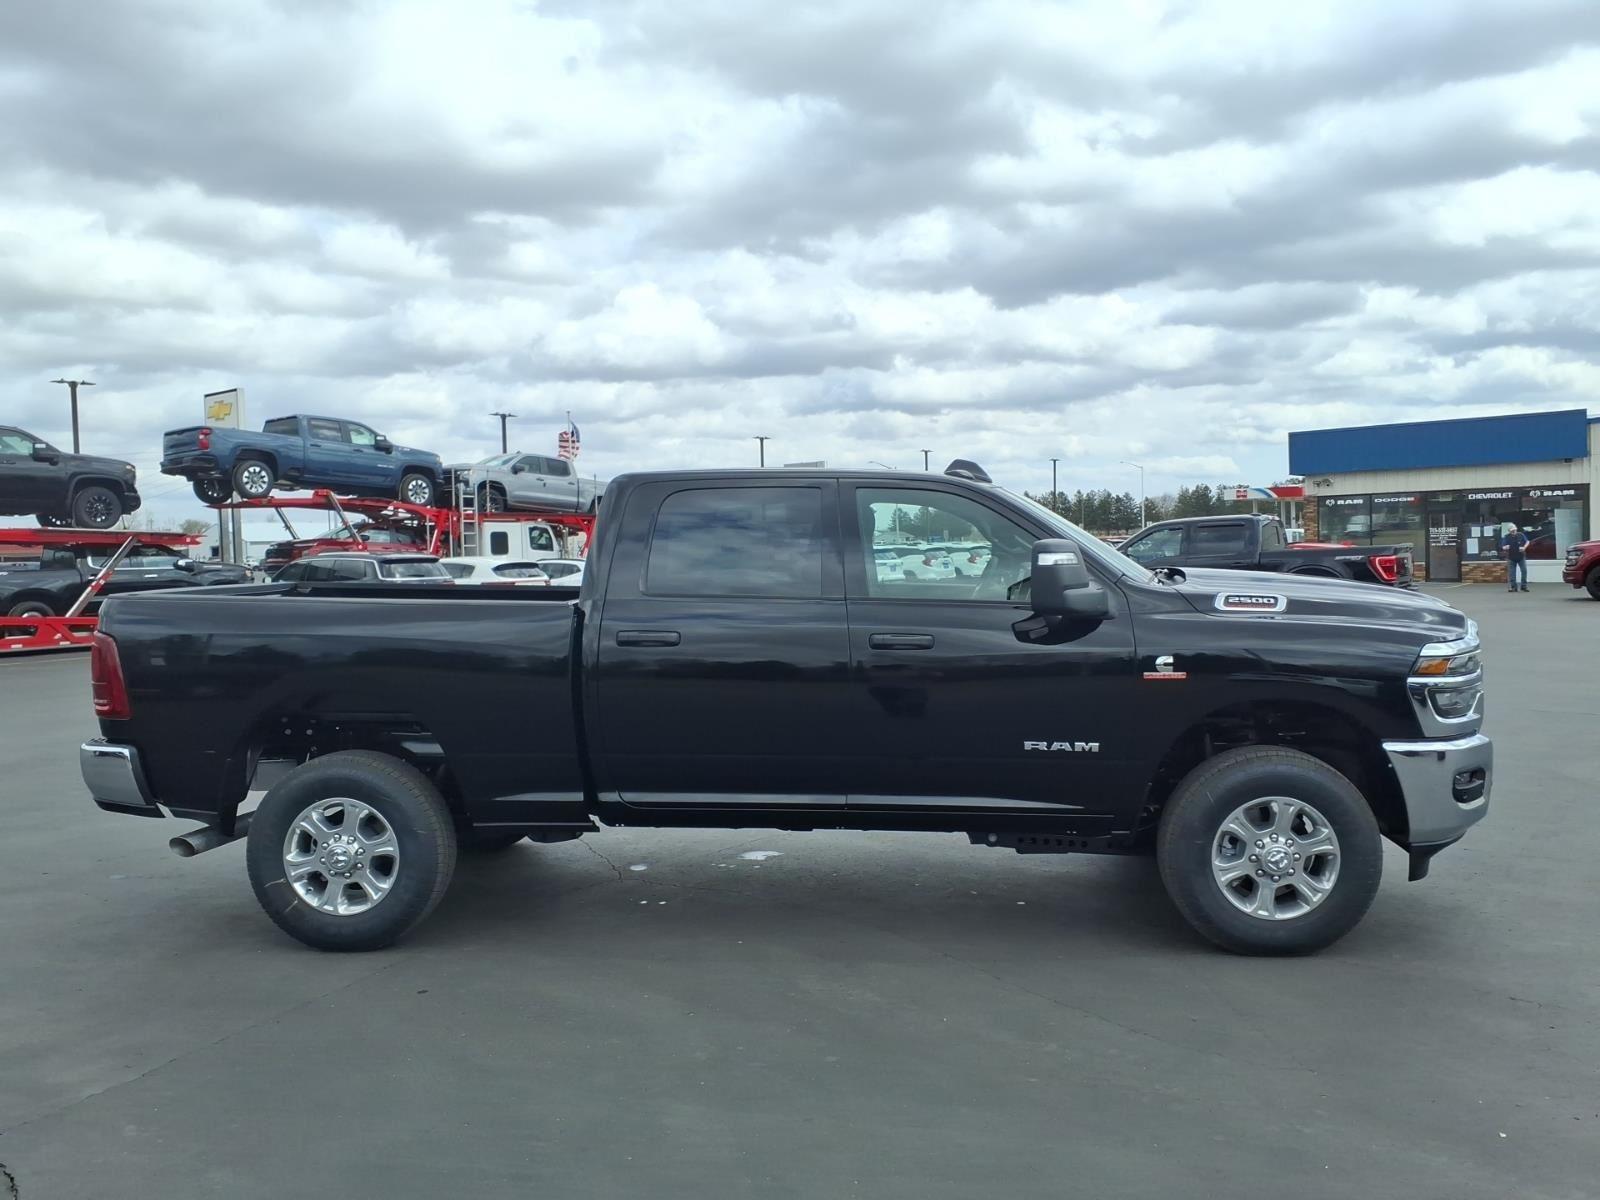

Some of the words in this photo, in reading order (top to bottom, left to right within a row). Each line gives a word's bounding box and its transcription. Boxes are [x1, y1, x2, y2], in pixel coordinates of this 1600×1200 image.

[1468, 492, 1512, 500] CHEVROLET
[1228, 596, 1275, 604] 2500
[1023, 741, 1100, 752] RAM
